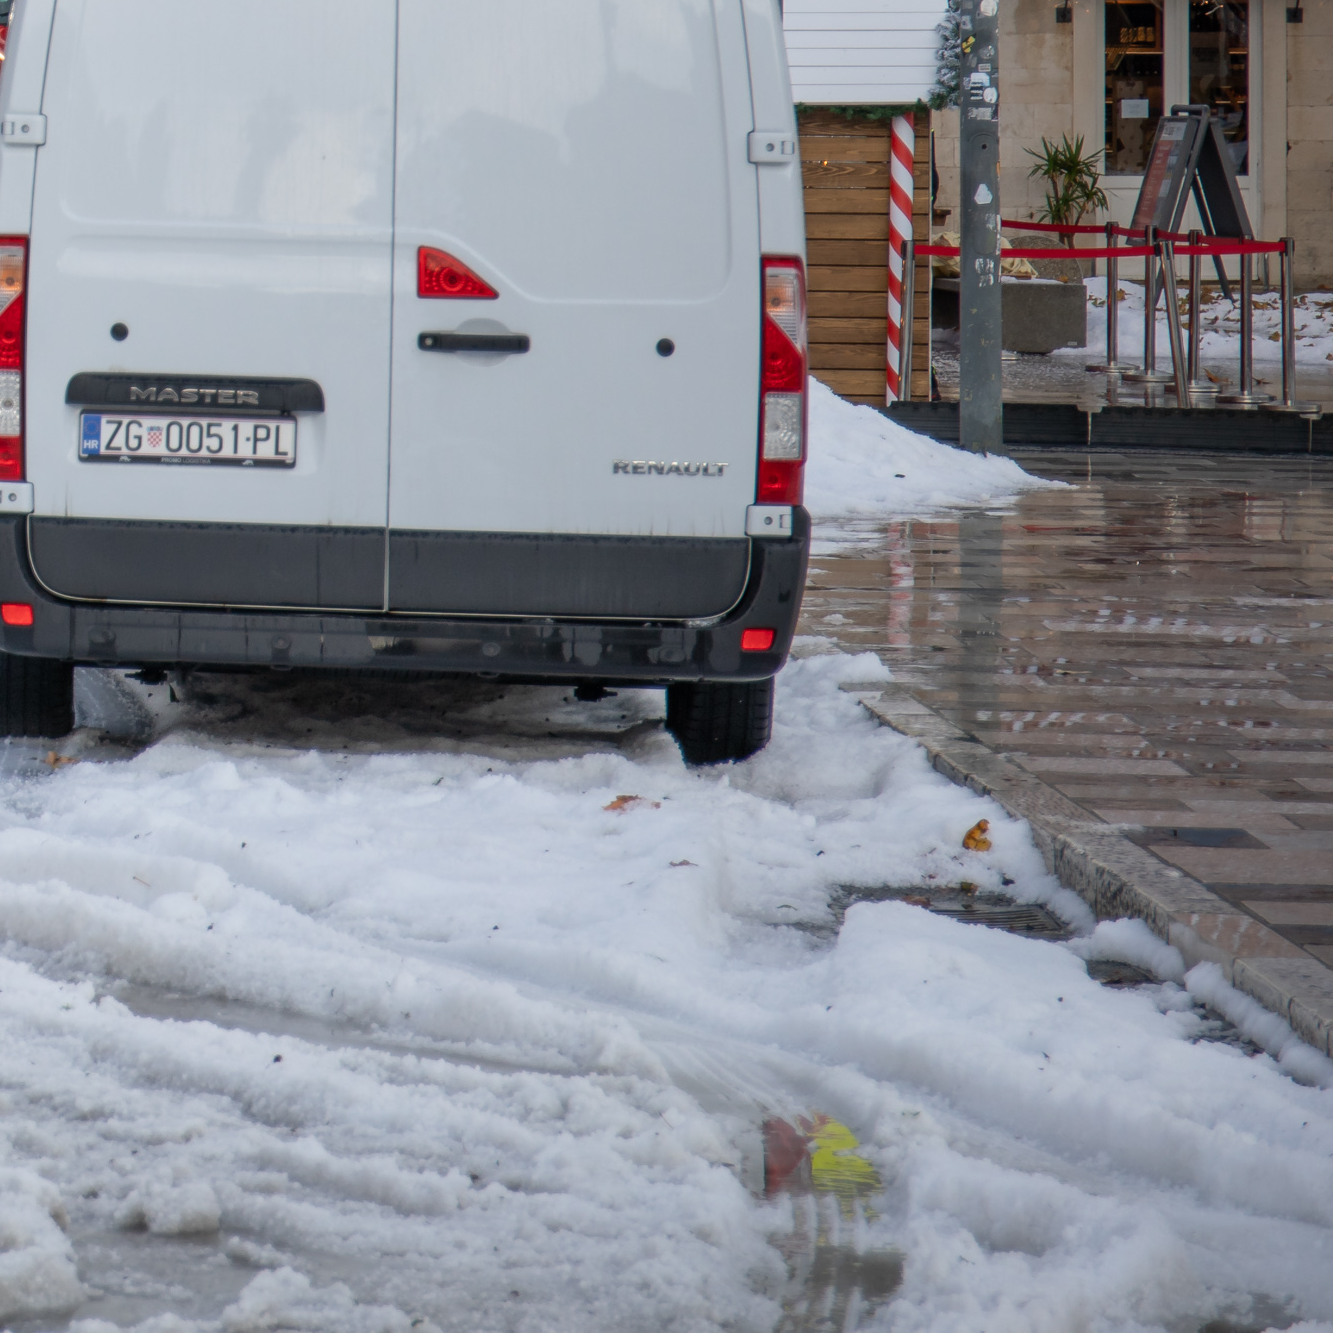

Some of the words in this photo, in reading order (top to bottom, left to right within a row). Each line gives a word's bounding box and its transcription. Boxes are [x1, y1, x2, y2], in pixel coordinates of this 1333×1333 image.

[130, 386, 259, 405] MASTER
[83, 439, 99, 450] HR
[104, 419, 143, 452] ZG
[612, 459, 729, 477] RENAULT
